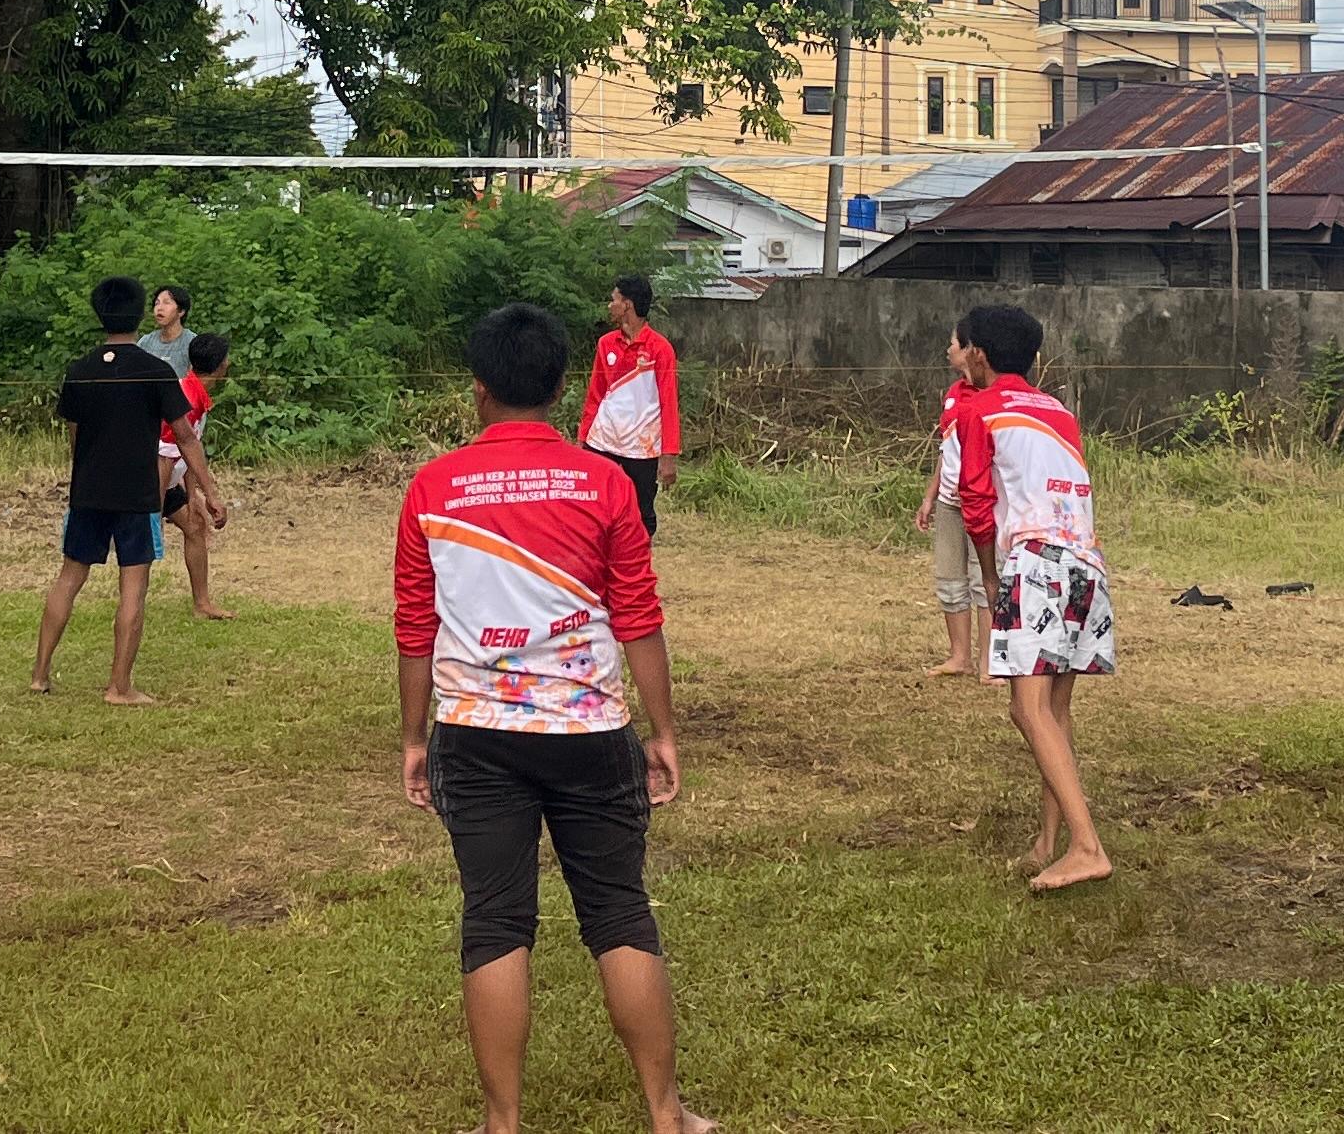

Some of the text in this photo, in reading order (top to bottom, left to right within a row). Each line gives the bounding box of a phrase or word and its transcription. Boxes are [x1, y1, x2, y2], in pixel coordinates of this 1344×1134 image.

[451, 468, 588, 487] KULIAH KERJA NYATA TEMATIK
[464, 479, 576, 495] PERIODE VI TAHUN 2025
[444, 489, 598, 511] UNIVERSITAS DEHASEN BENGKULU
[479, 627, 531, 648] DEHA
